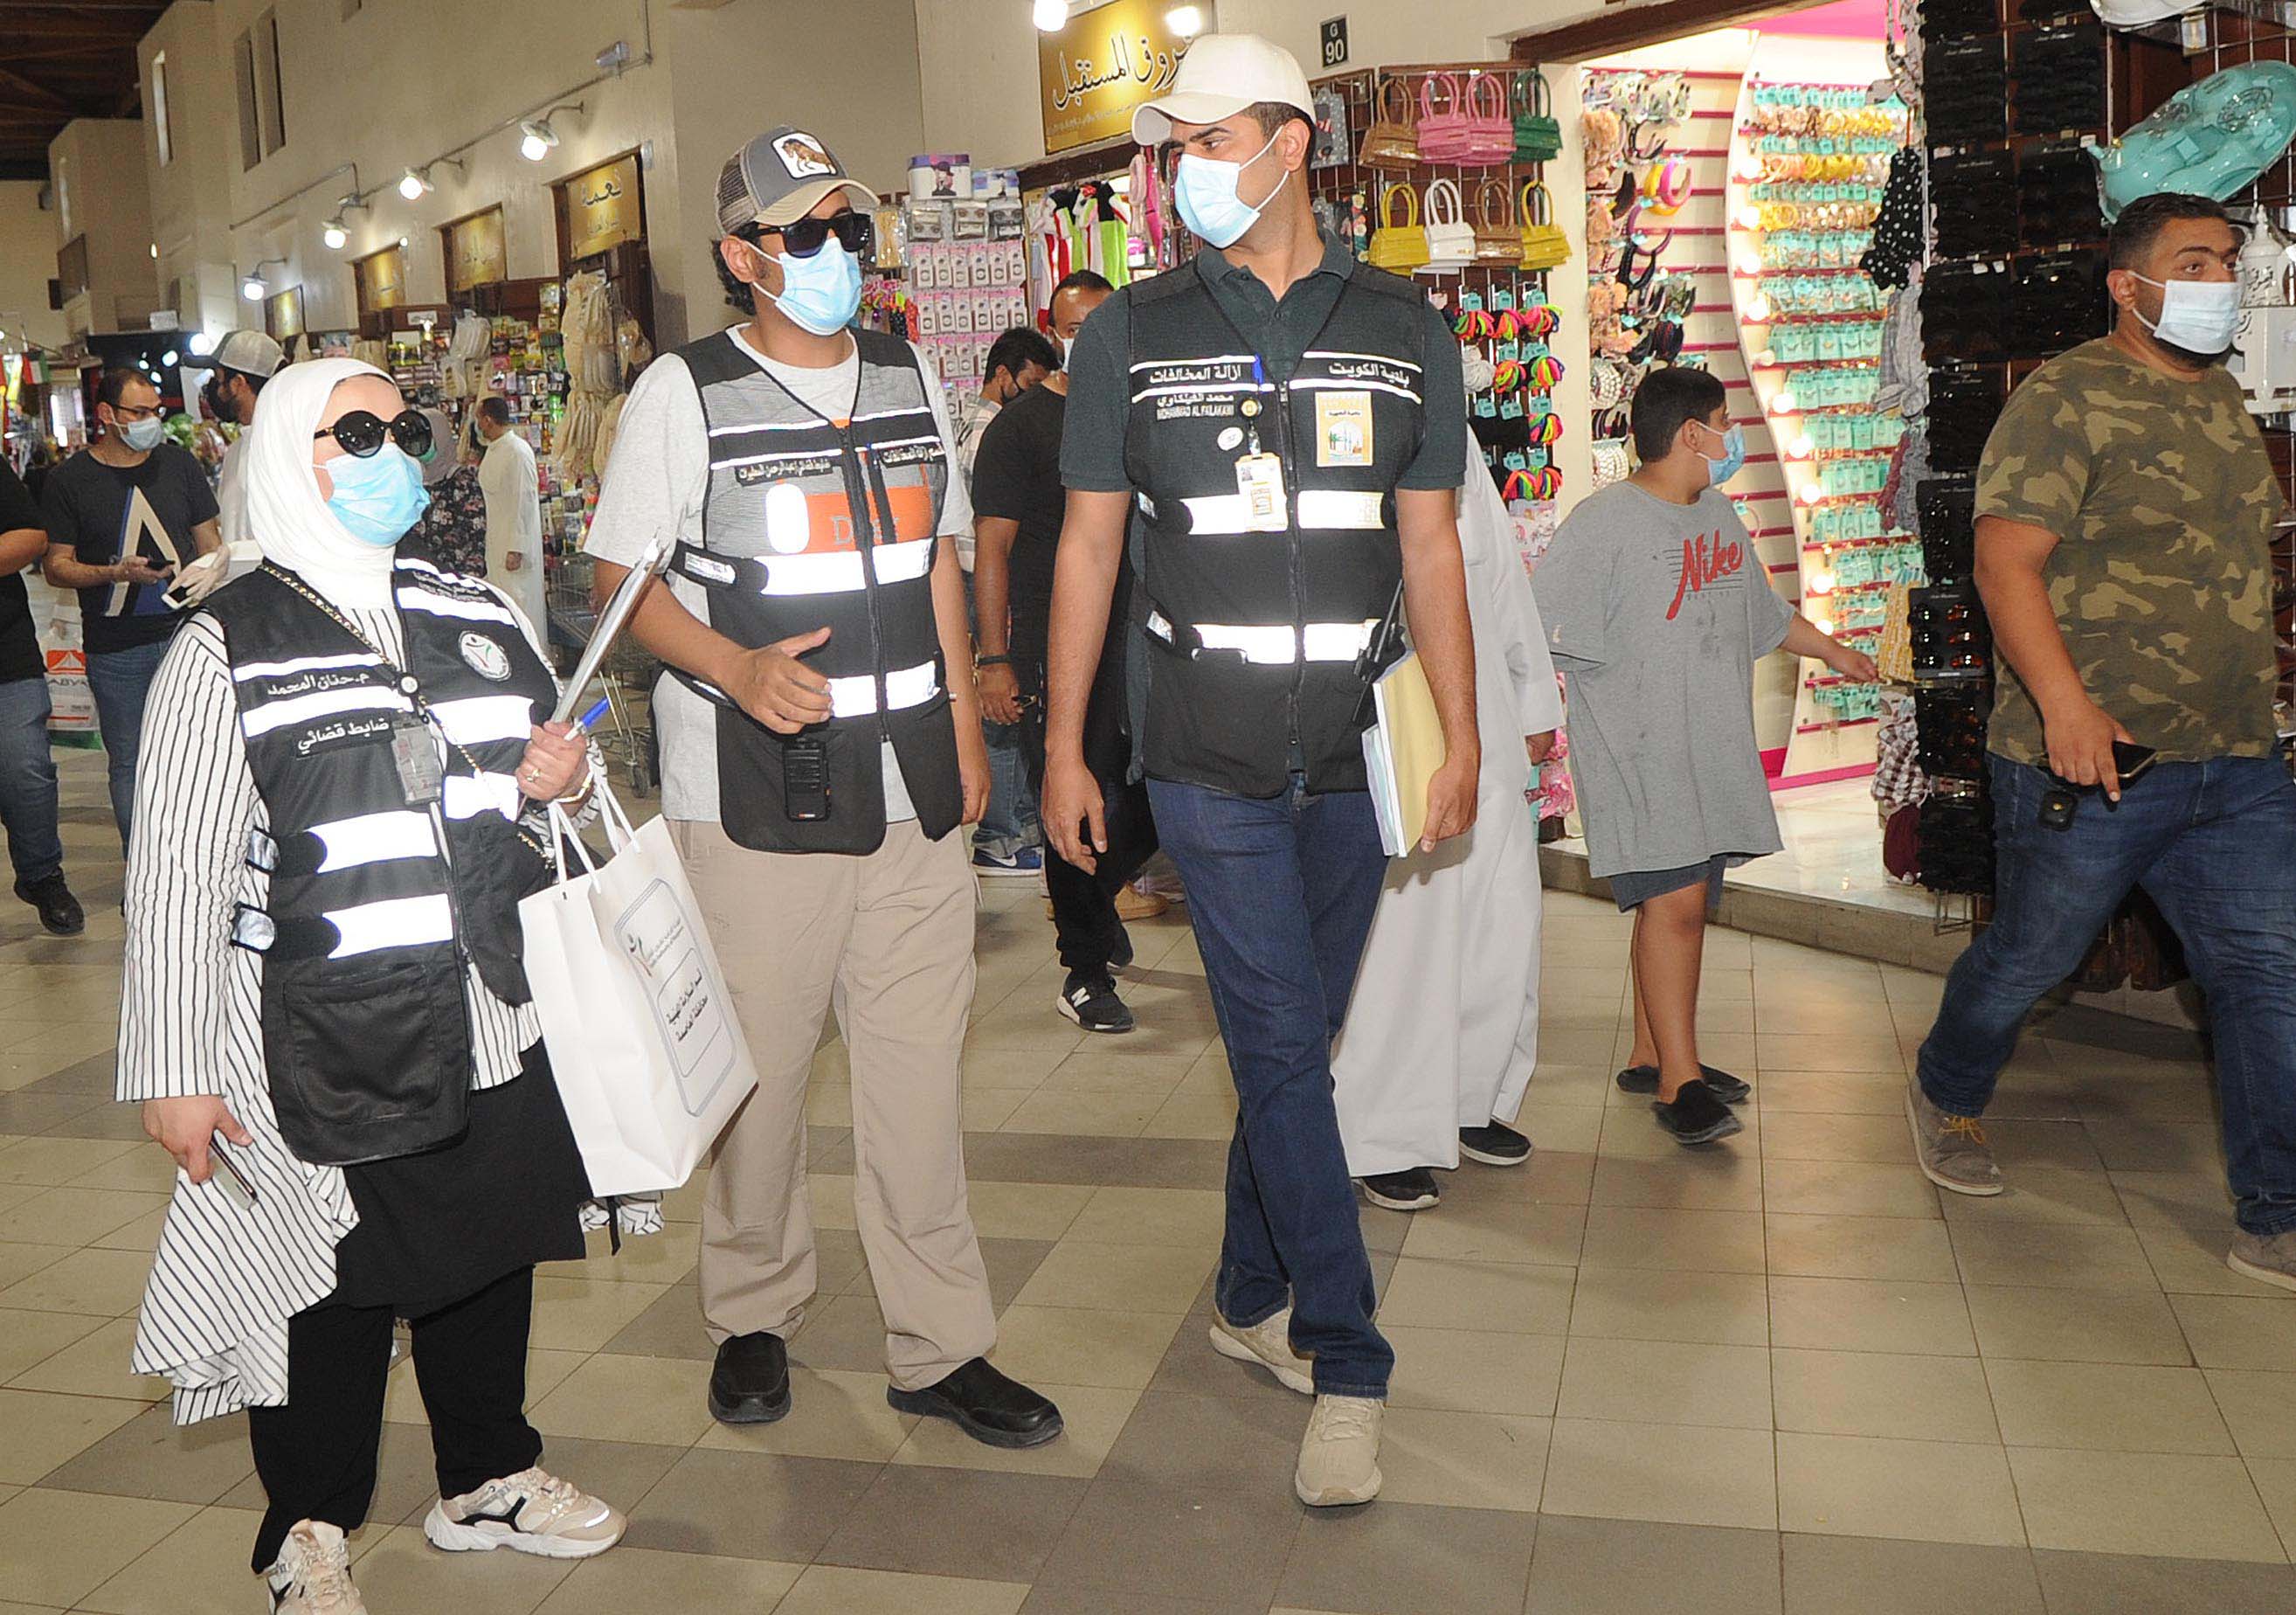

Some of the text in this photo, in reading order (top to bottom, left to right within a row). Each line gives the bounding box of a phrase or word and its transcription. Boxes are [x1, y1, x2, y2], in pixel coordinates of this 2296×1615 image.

[1330, 23, 1338, 38] G
[1325, 38, 1345, 64] 90
[1052, 31, 1131, 109] المستقبل
[1149, 366, 1211, 384] المخالفات
[1329, 362, 1410, 388] بلدية الكويت
[1665, 528, 1743, 620] Nike
[267, 674, 316, 696] المحمد
[297, 717, 391, 755] ضابط قضائي
